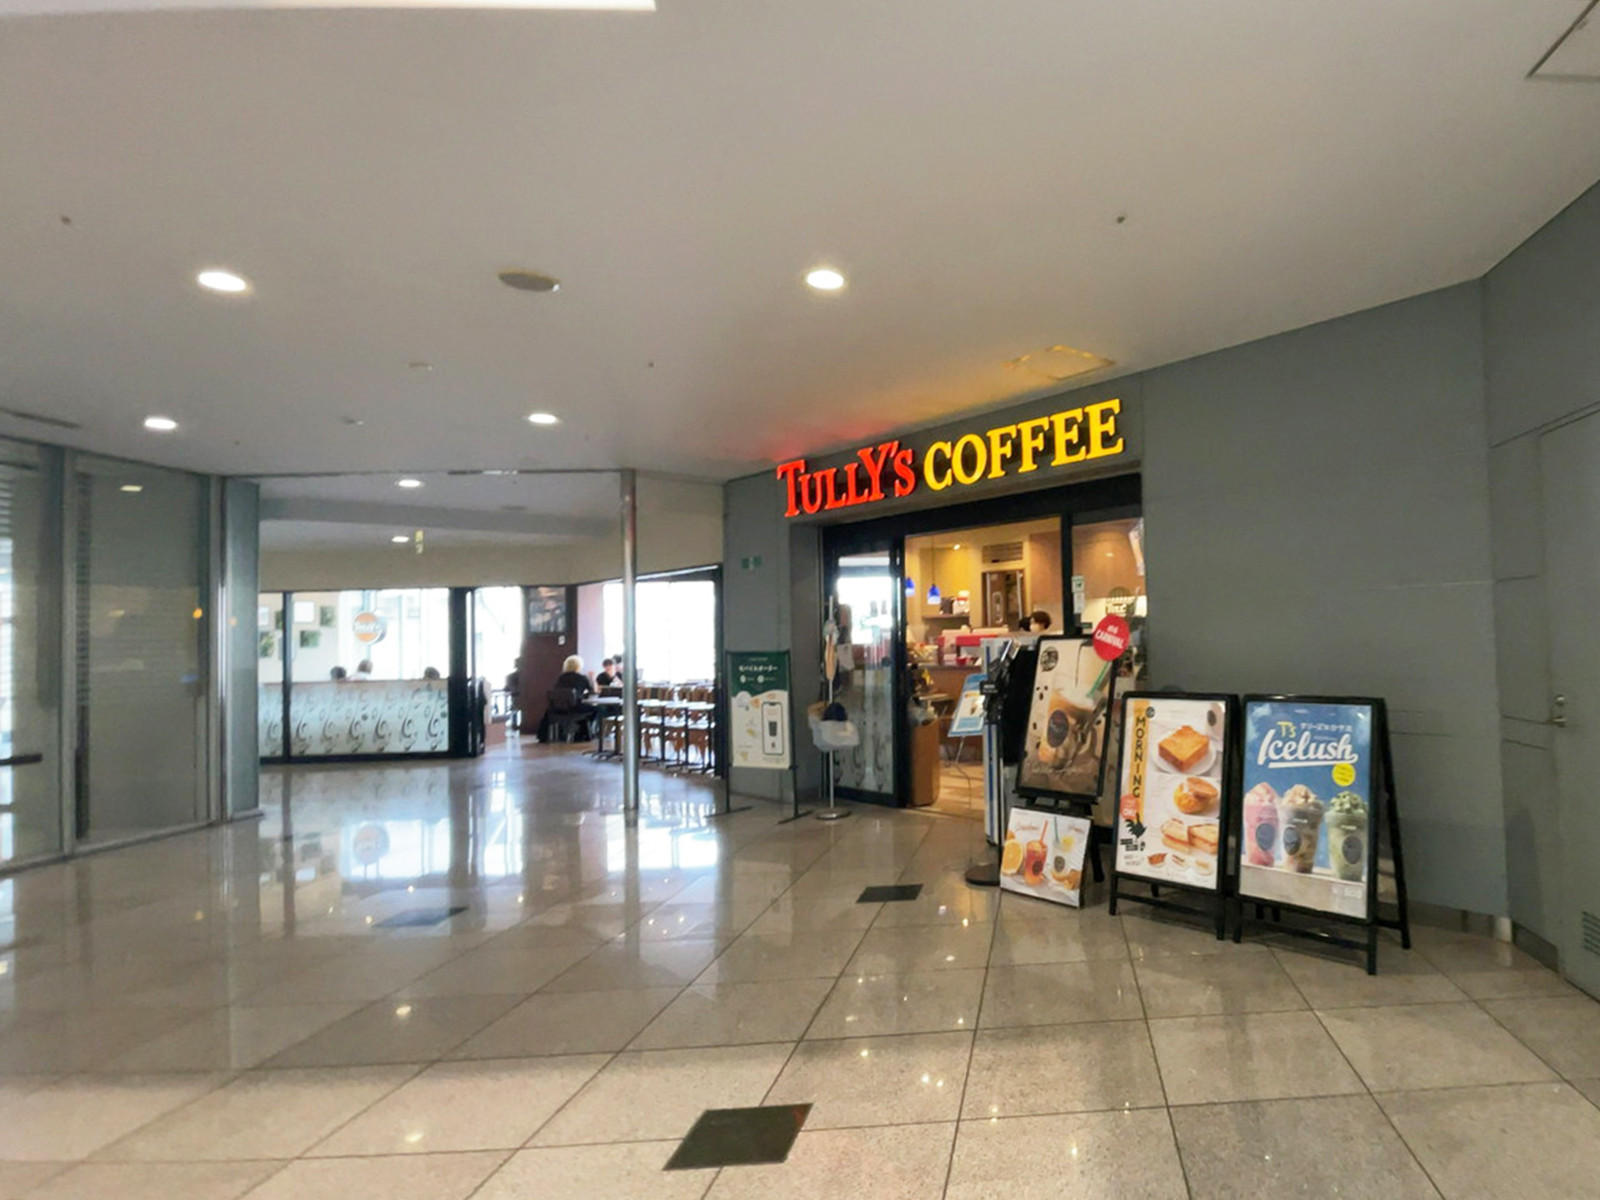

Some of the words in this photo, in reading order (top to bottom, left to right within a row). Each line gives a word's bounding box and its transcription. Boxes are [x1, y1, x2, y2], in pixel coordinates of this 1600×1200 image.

[924, 398, 1124, 491] COFFEE
[1095, 629, 1125, 650] CARNIVAL
[1132, 716, 1147, 798] MORNING
[1257, 729, 1359, 767] Icelush
